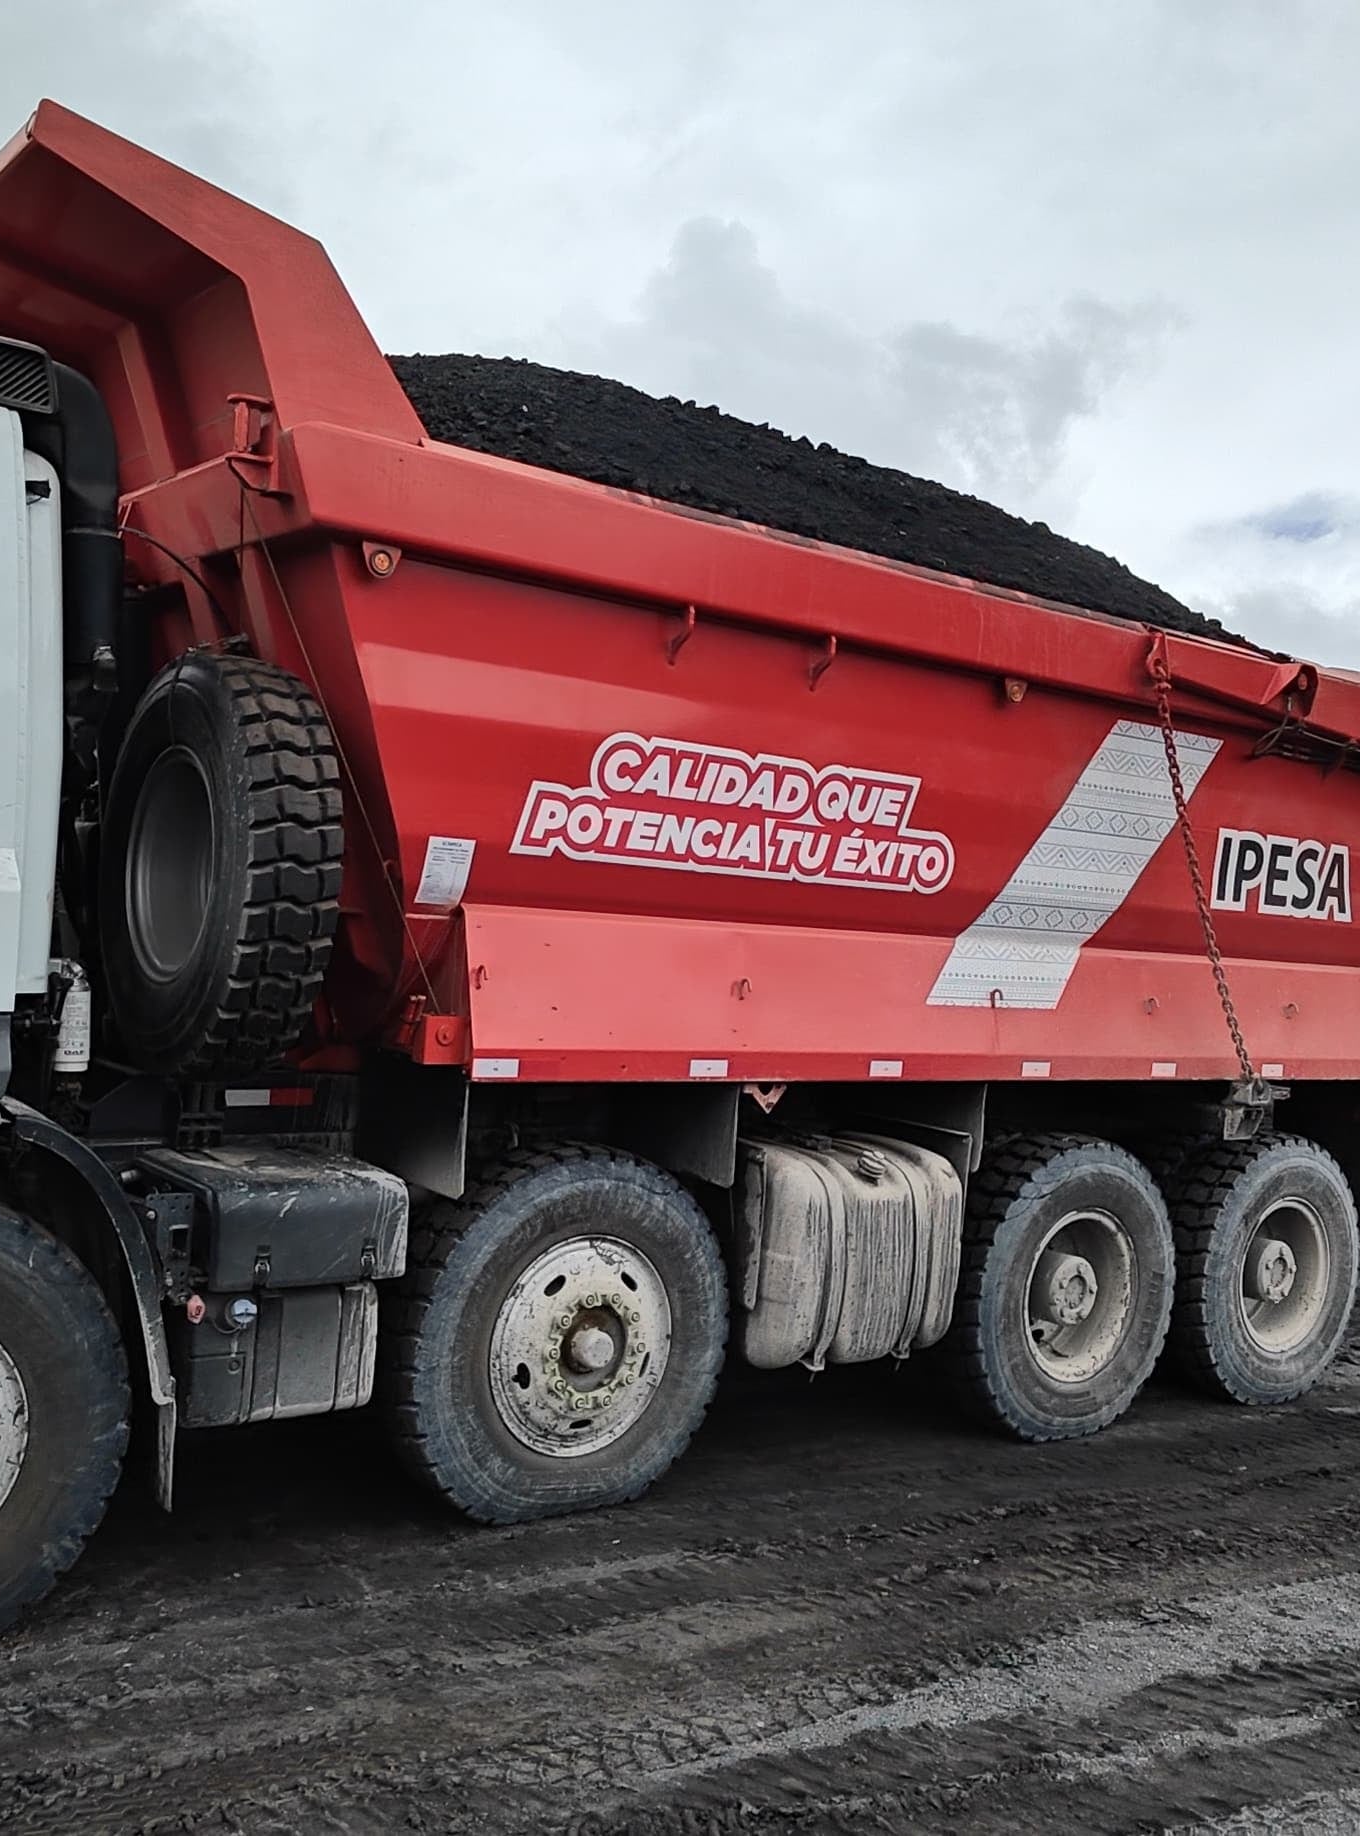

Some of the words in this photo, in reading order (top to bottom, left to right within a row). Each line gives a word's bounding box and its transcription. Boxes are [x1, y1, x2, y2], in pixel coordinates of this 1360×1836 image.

[603, 748, 809, 814] CALIDAD
[817, 780, 906, 828] QUE
[530, 797, 763, 864] POTENCIA
[774, 830, 831, 868] TU
[835, 830, 945, 883] ÉXITO
[1216, 837, 1346, 914] IPESA
